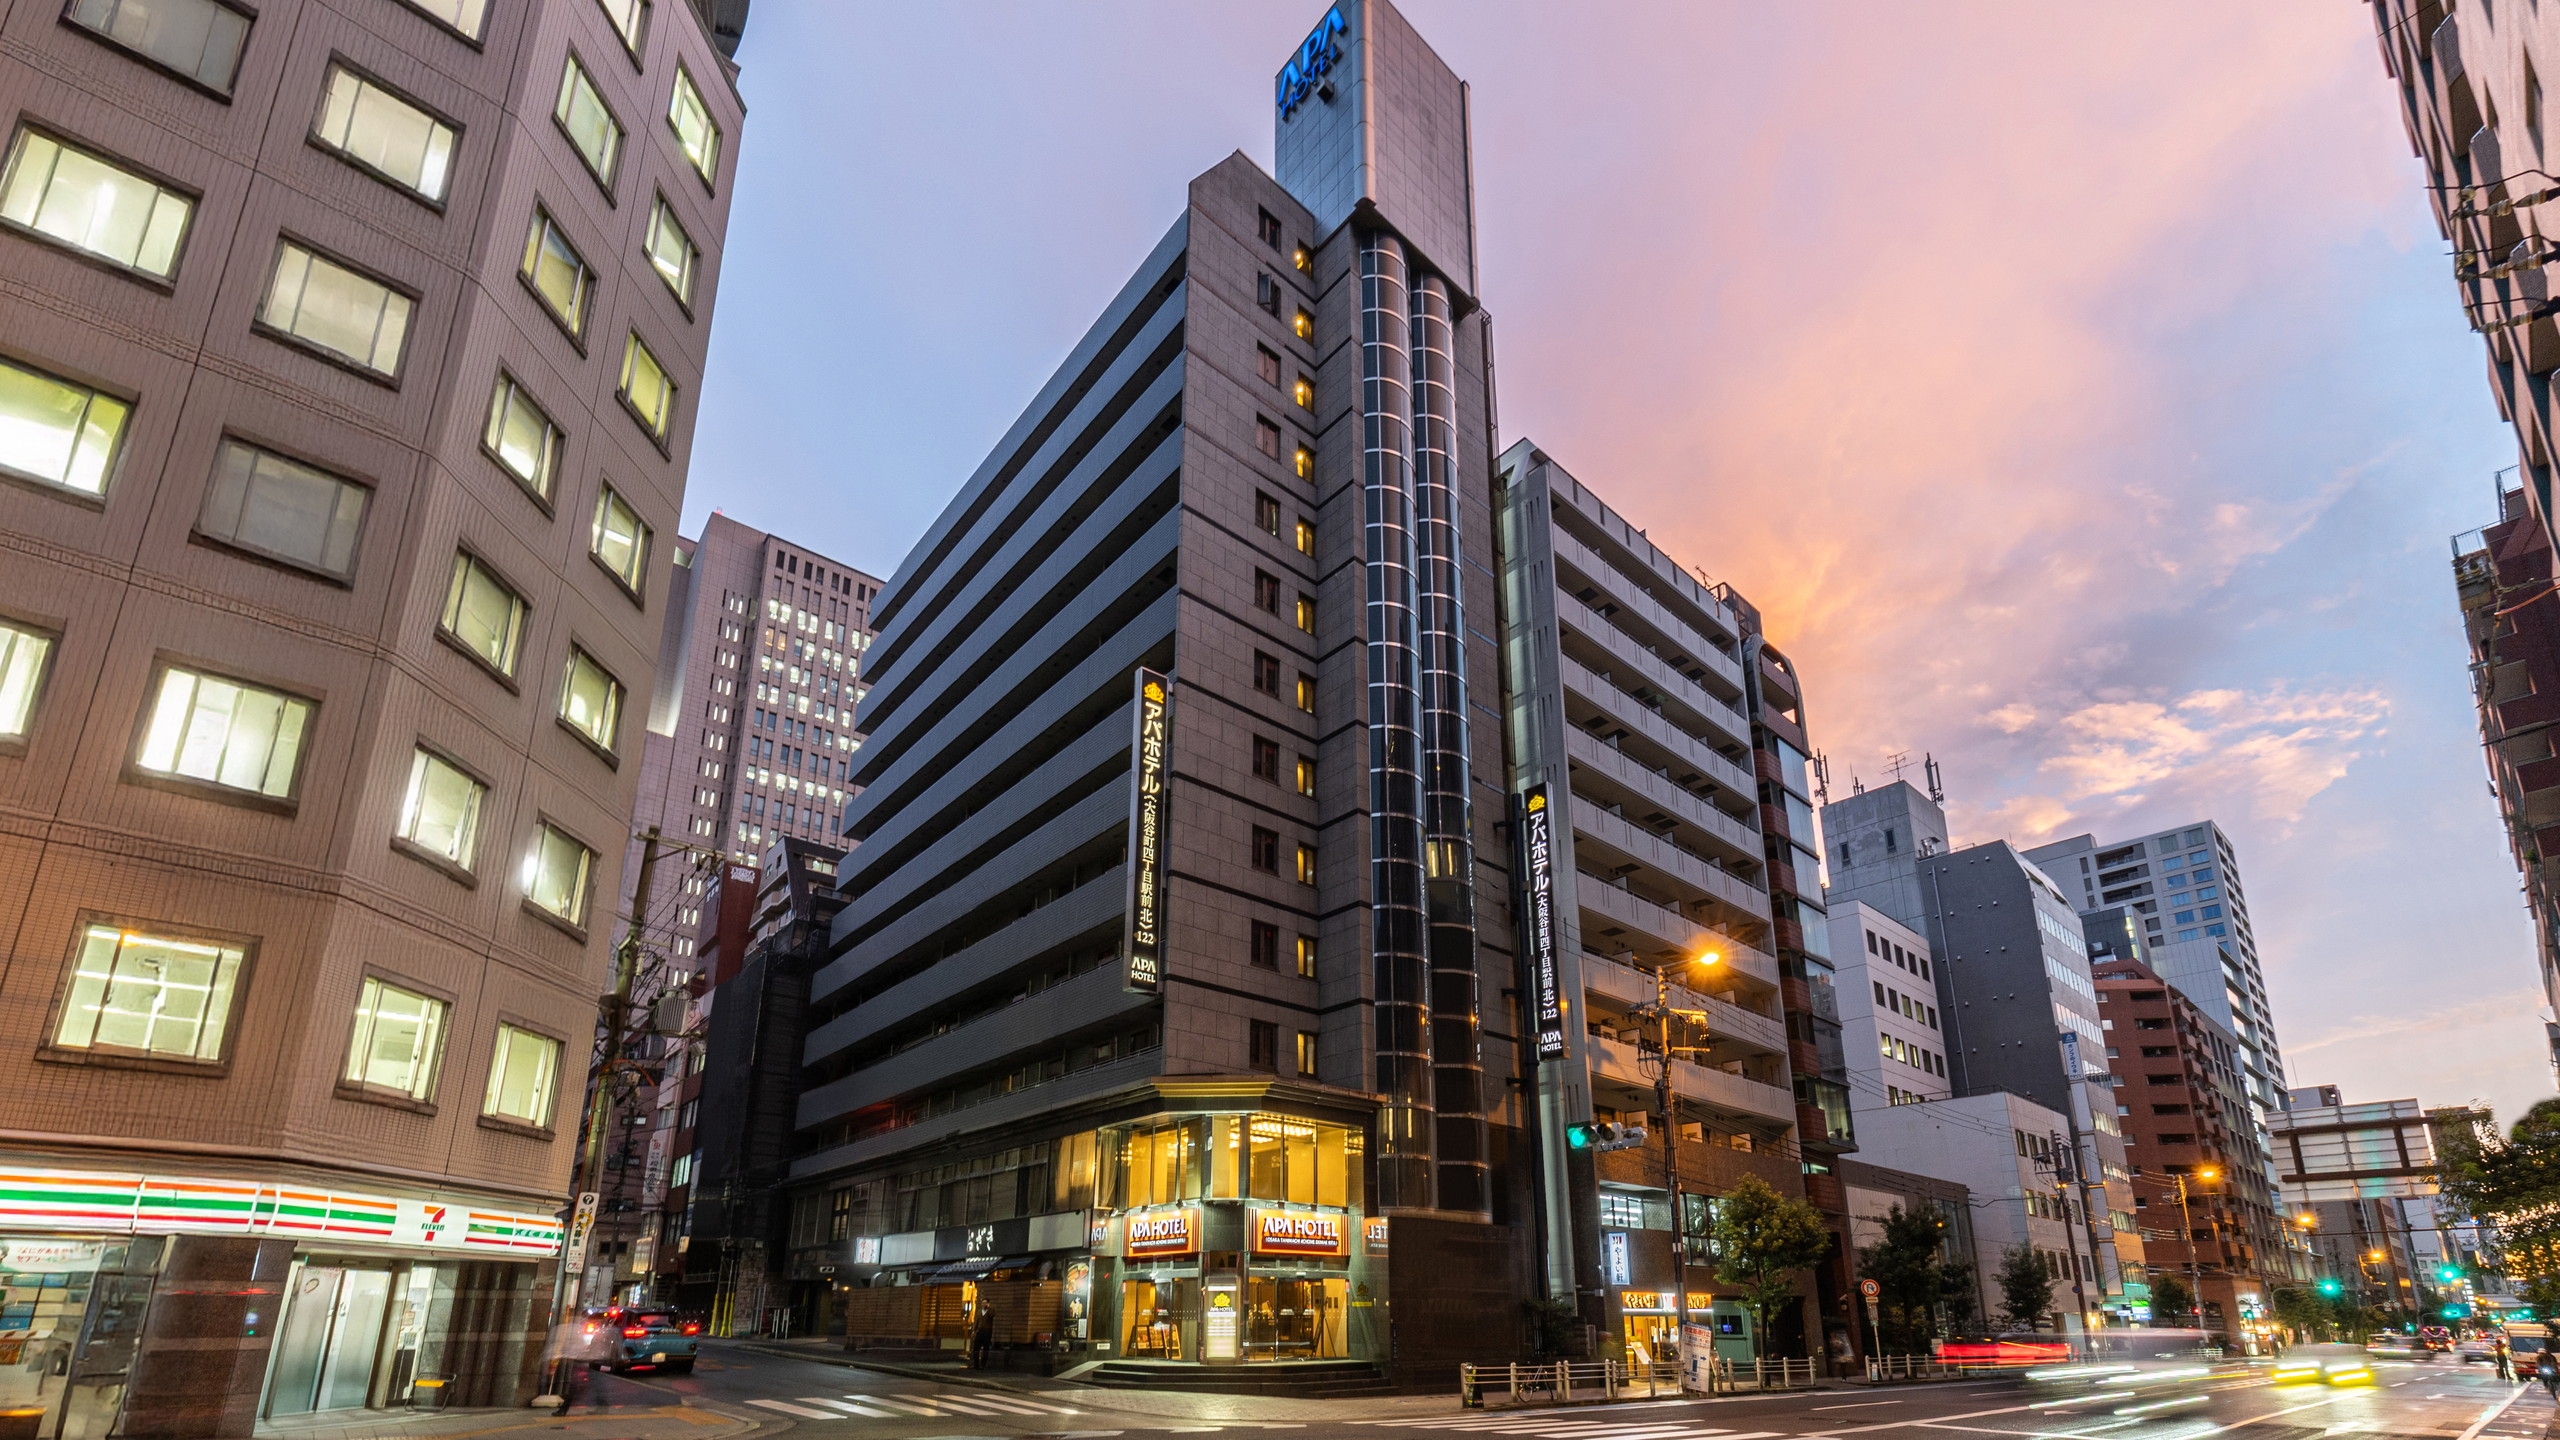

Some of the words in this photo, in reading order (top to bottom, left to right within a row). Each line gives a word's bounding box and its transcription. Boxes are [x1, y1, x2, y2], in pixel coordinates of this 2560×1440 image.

[1278, 7, 1345, 105] APA
[1281, 43, 1338, 118] HOTEL
[1136, 930, 1155, 945] 122
[1131, 956, 1157, 973] APA
[1131, 969, 1156, 983] HOTEL
[1542, 1007, 1558, 1020] 122
[1540, 1030, 1562, 1045] APA
[1541, 1043, 1562, 1053] HOTEL
[1130, 1222, 1150, 1238] APA
[1151, 1218, 1188, 1237] HOTEL
[1264, 1216, 1292, 1234] APA
[1294, 1219, 1339, 1237] HOTEL
[1614, 1247, 1624, 1283] やよい軒
